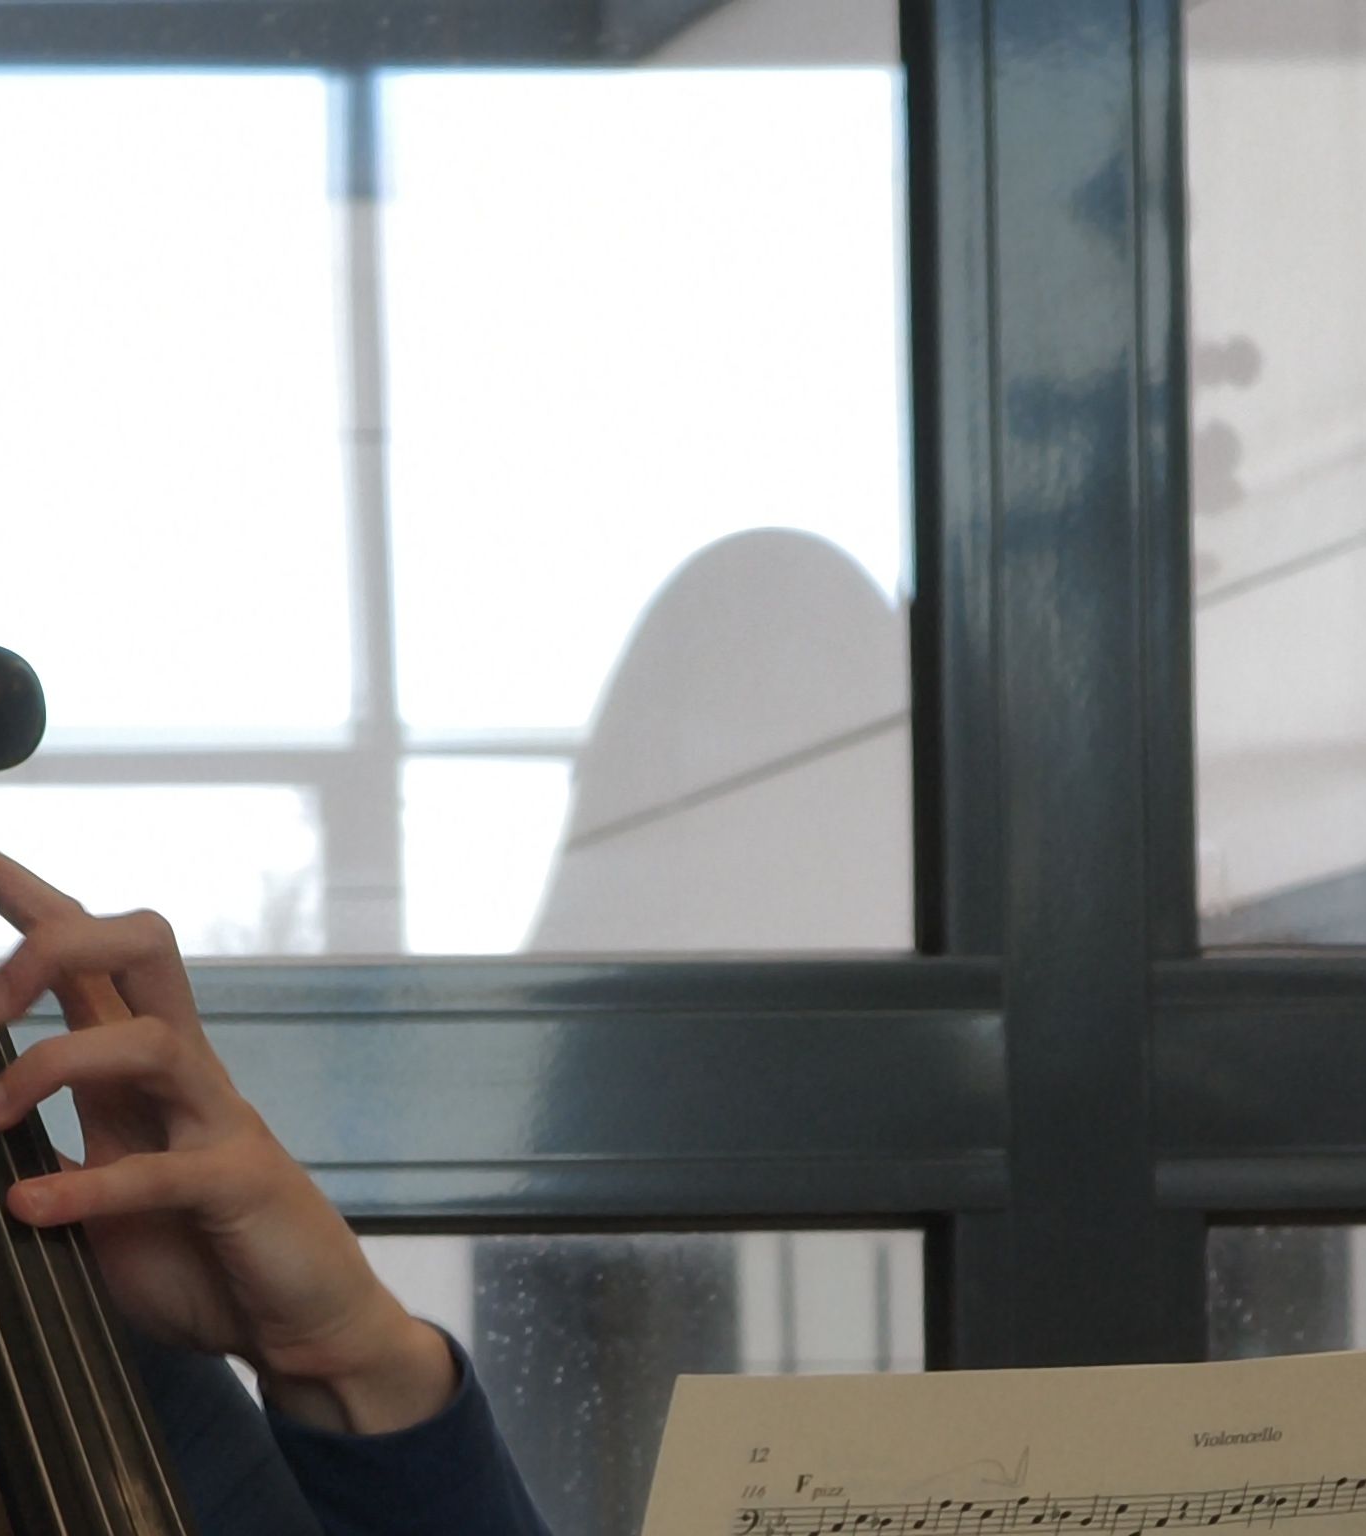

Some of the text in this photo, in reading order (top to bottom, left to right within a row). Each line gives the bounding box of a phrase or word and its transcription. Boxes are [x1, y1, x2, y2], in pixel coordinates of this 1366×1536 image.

[1193, 1427, 1283, 1448] Violoncello
[749, 1447, 771, 1463] 12
[795, 1474, 814, 1493] F
